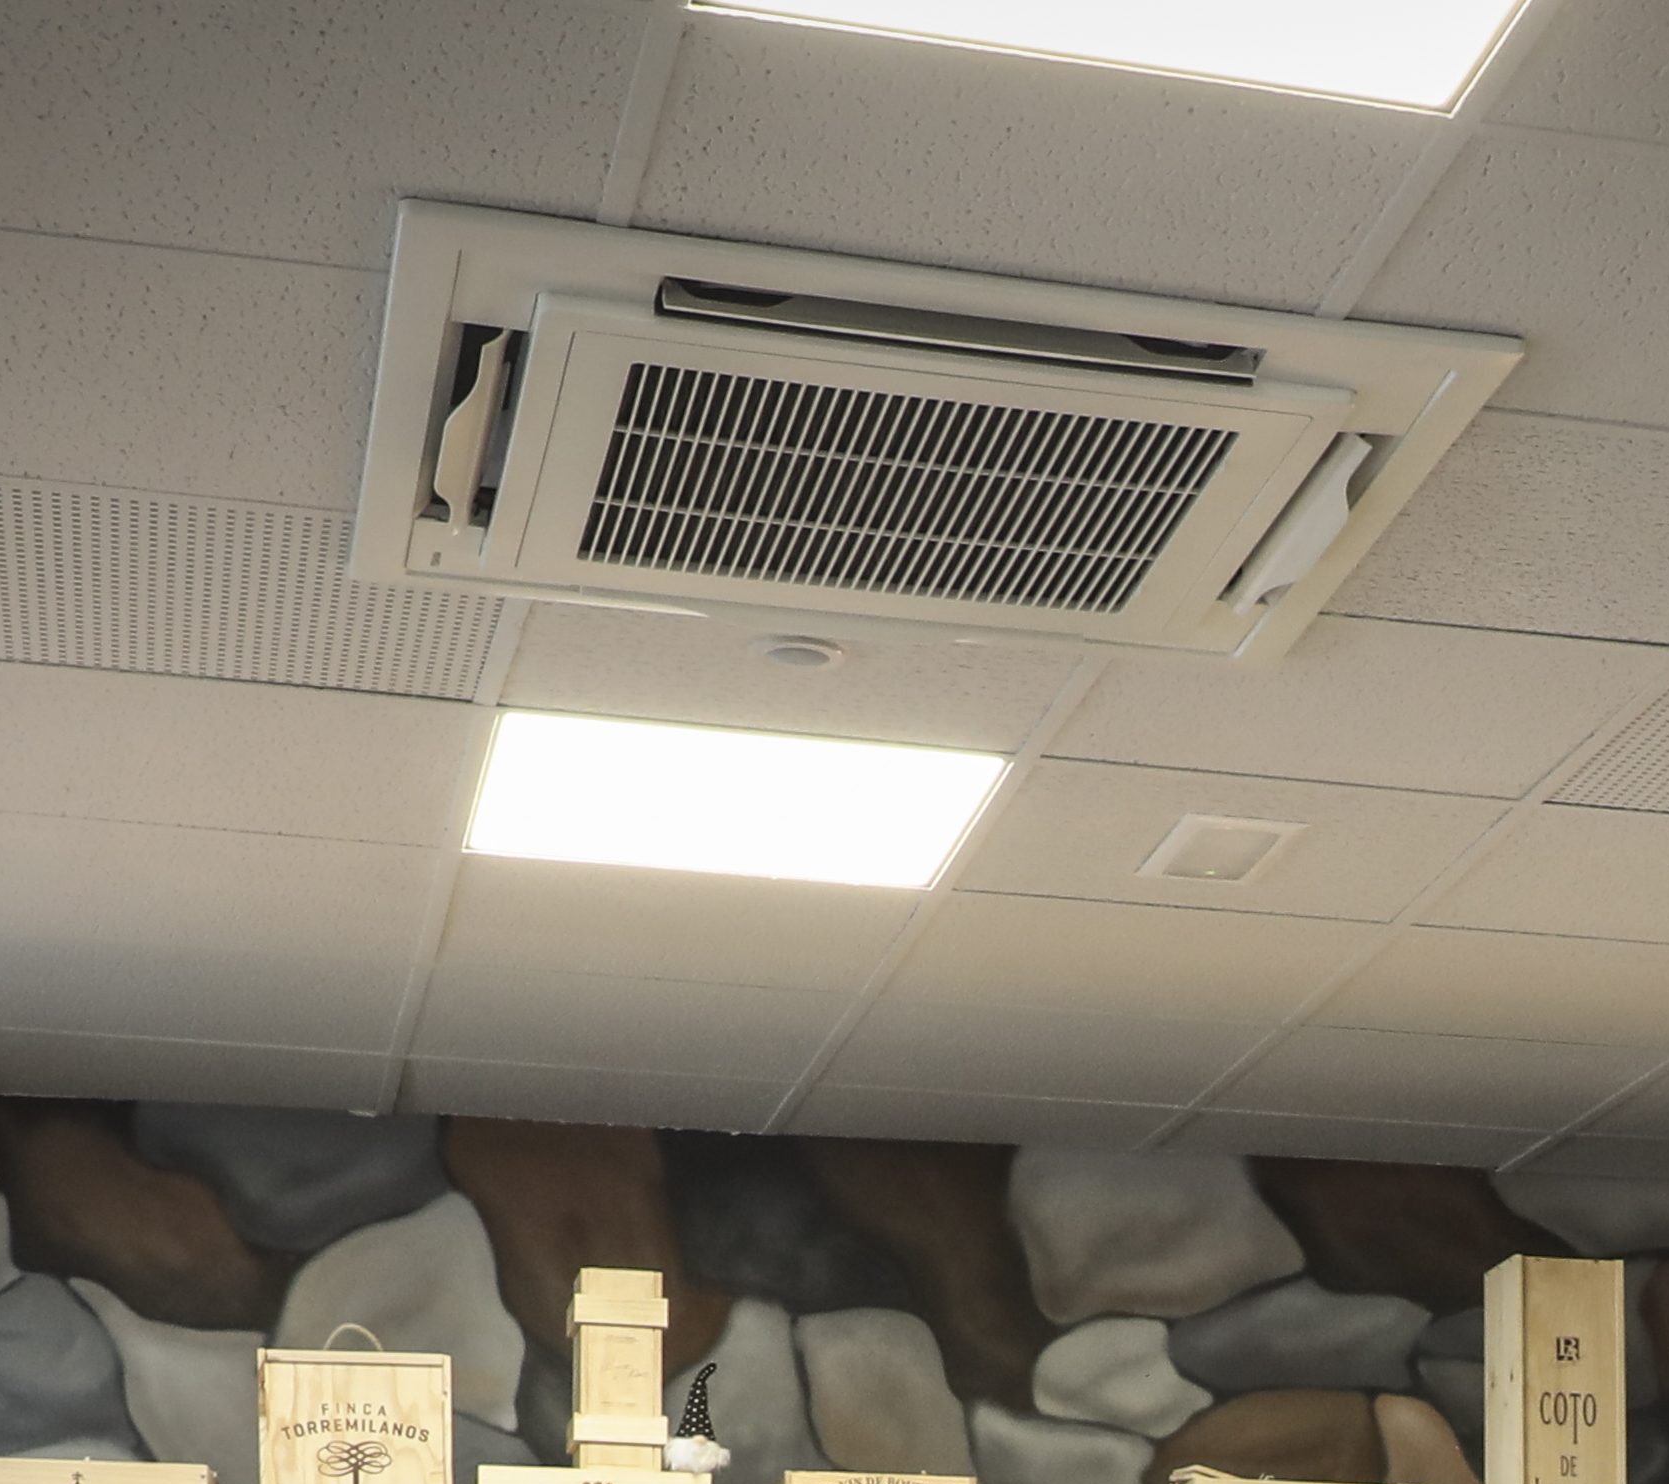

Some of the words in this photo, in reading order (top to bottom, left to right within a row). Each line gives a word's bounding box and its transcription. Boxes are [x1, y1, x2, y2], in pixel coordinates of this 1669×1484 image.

[321, 1402, 387, 1416] FINCA
[1539, 1391, 1597, 1445] COTO
[281, 1418, 430, 1443] TORREMILANOS
[1560, 1455, 1578, 1477] DE
